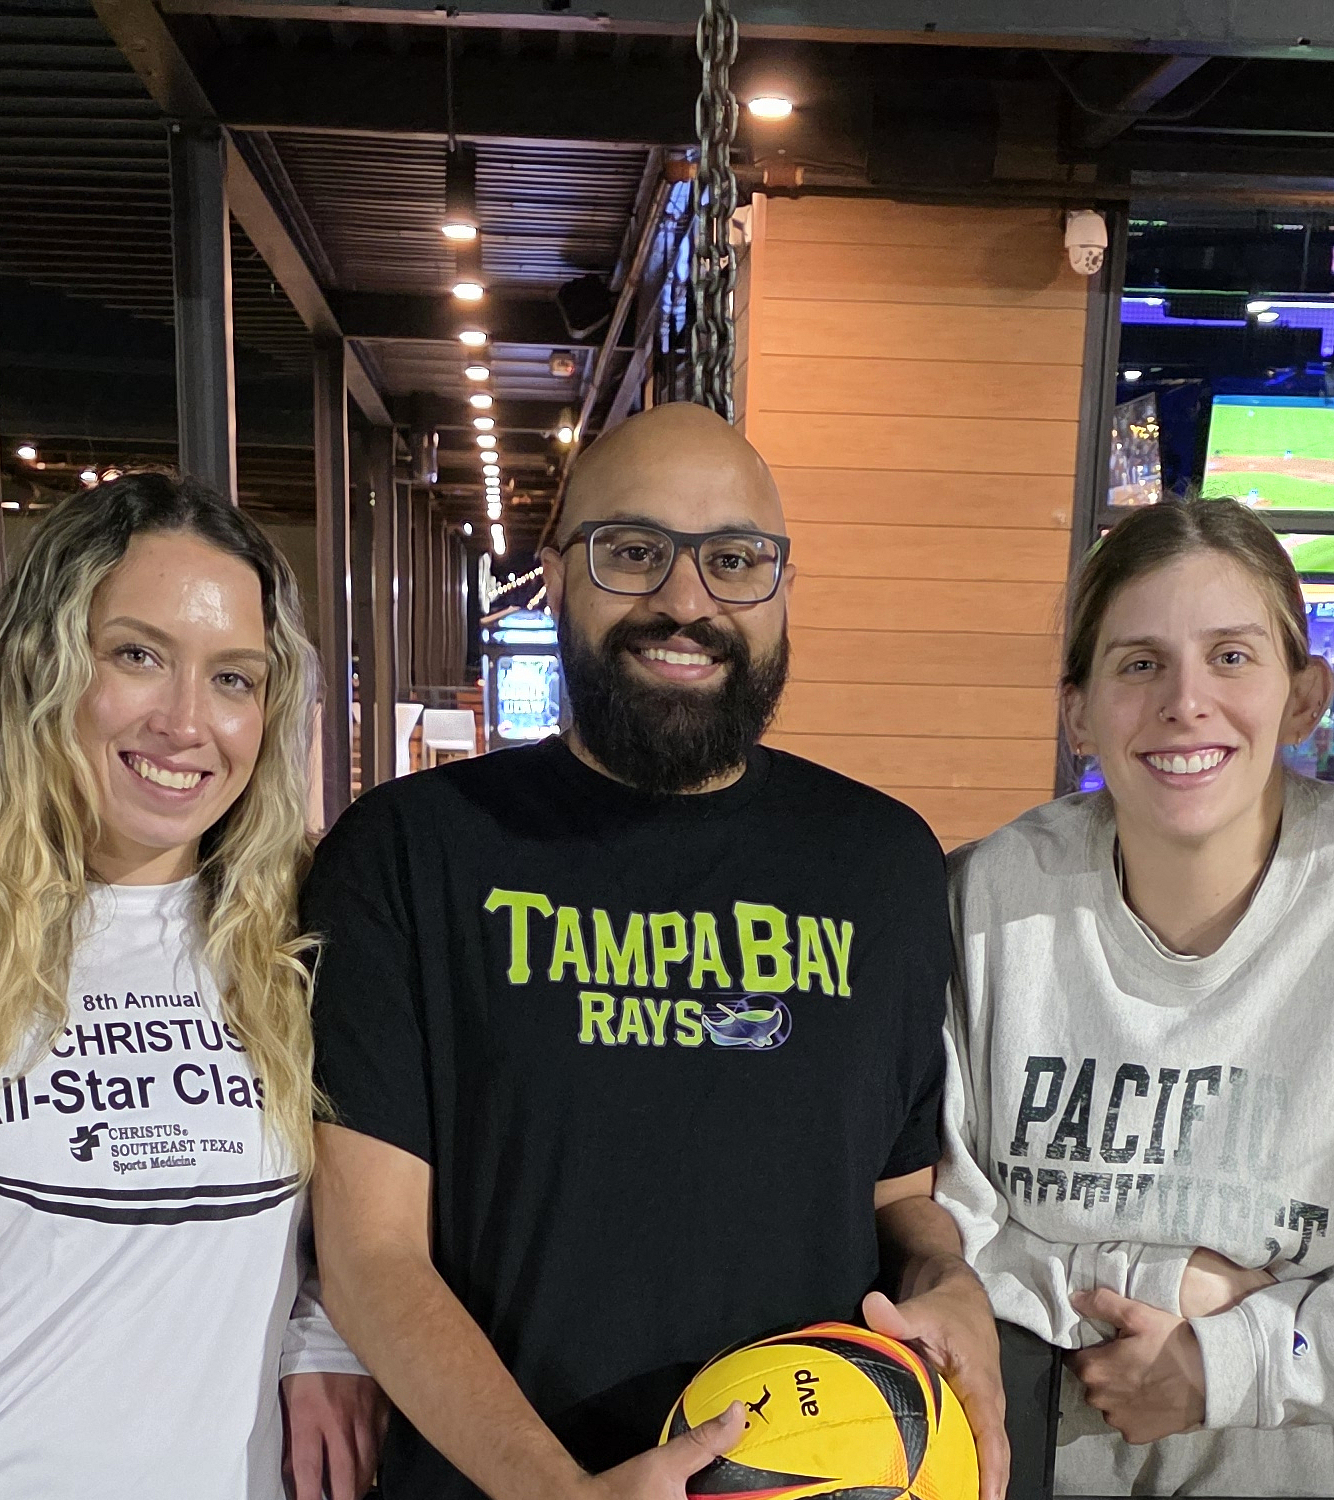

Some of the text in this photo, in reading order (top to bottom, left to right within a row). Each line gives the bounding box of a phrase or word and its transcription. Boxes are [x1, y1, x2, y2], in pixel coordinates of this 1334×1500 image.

[82, 991, 202, 1012] 8th Annual
[577, 990, 706, 1048] RAYS
[51, 1018, 247, 1059] CHRISTUS
[110, 1139, 244, 1158] SOUTHEAST TEXAS
[113, 1155, 197, 1175] Sports Medicine
